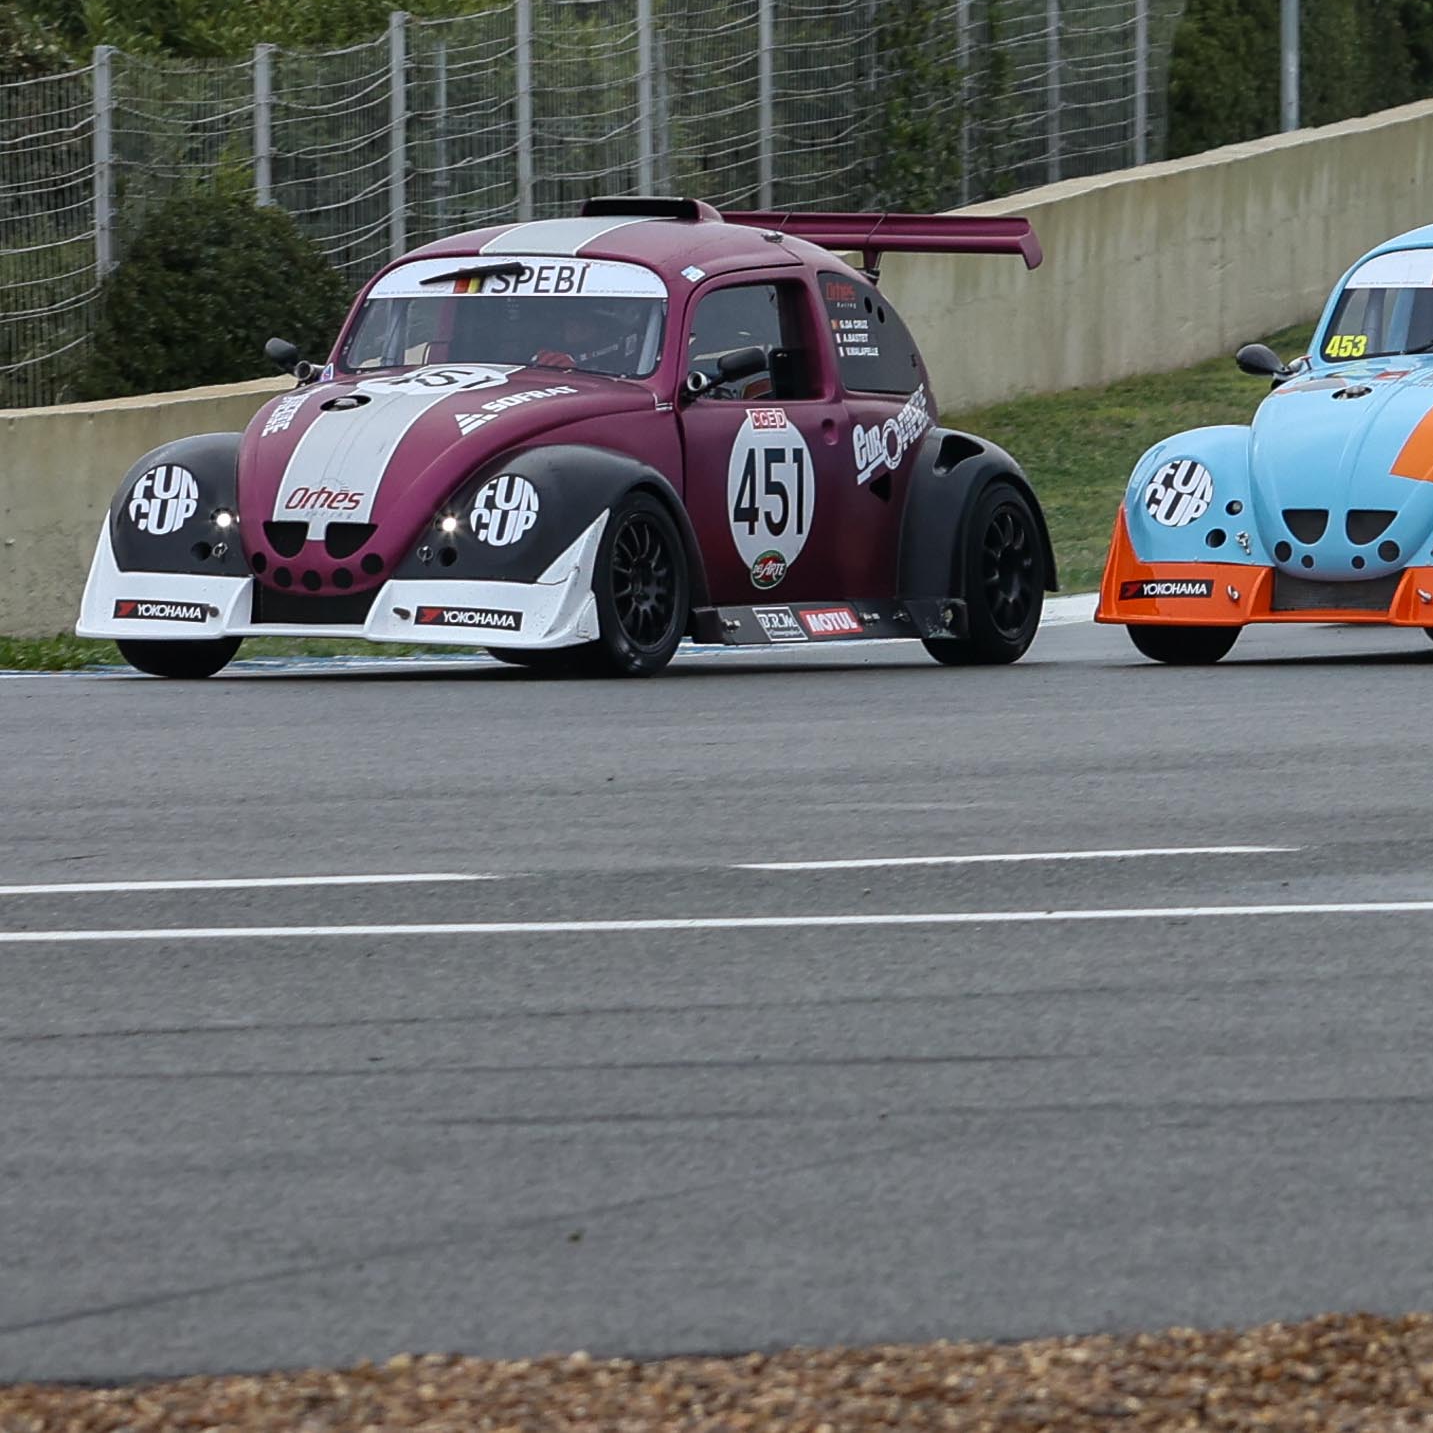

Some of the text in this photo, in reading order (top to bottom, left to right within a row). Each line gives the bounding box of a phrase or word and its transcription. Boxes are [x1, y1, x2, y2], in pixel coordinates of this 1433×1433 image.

[1325, 334, 1368, 358] 453
[482, 385, 578, 413] SOFRAT
[133, 465, 199, 499] FUN
[474, 475, 540, 511] FUN
[733, 448, 804, 537] 451
[1156, 460, 1213, 501] FUN
[129, 498, 199, 535] CUP
[1145, 483, 1203, 527] CUP
[470, 509, 538, 546] CUP
[1142, 583, 1208, 597] YOKOHAMA
[137, 603, 202, 620] YOKOHAMA
[442, 610, 516, 628] YOKOHAMA
[804, 610, 858, 633] MOTUL
